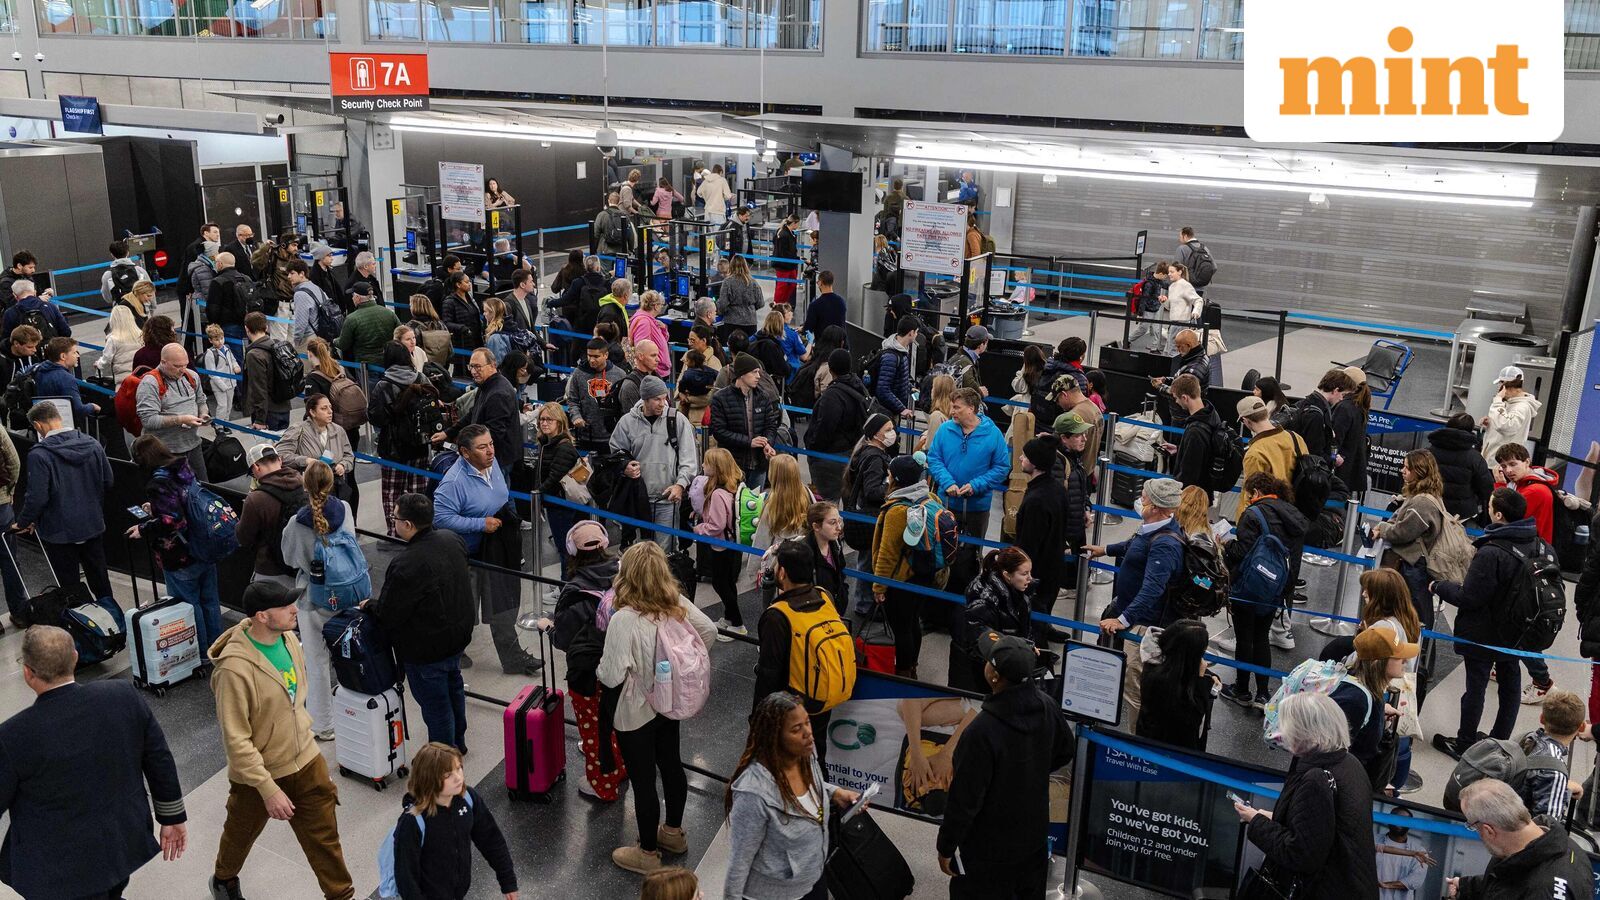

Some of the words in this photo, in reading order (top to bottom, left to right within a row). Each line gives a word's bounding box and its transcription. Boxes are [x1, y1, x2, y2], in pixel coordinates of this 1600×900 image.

[380, 62, 411, 86] 7A
[341, 100, 374, 110] Security
[376, 99, 402, 108] Check
[403, 99, 423, 108] Point
[393, 204, 400, 215] 5
[492, 216, 498, 226] 4
[708, 240, 713, 252] 2
[1371, 445, 1388, 454] ou've
[1106, 756, 1125, 766] Travel
[1126, 762, 1142, 771] With
[1142, 766, 1158, 776] Ease
[852, 768, 862, 778] to
[865, 772, 888, 783] your
[1111, 798, 1150, 818] You've
[1152, 810, 1172, 824] got
[1174, 815, 1201, 832] kids,
[1109, 813, 1122, 823] so
[1125, 816, 1159, 833] we've
[1161, 826, 1181, 839] got
[1184, 832, 1209, 847] you.
[1106, 837, 1122, 847] join
[1123, 842, 1139, 853] you
[1140, 846, 1152, 856] for
[1154, 850, 1172, 862] free.
[1107, 828, 1140, 844] Children
[1143, 838, 1154, 847] 12
[1155, 841, 1171, 851] and
[1172, 846, 1198, 859] under
